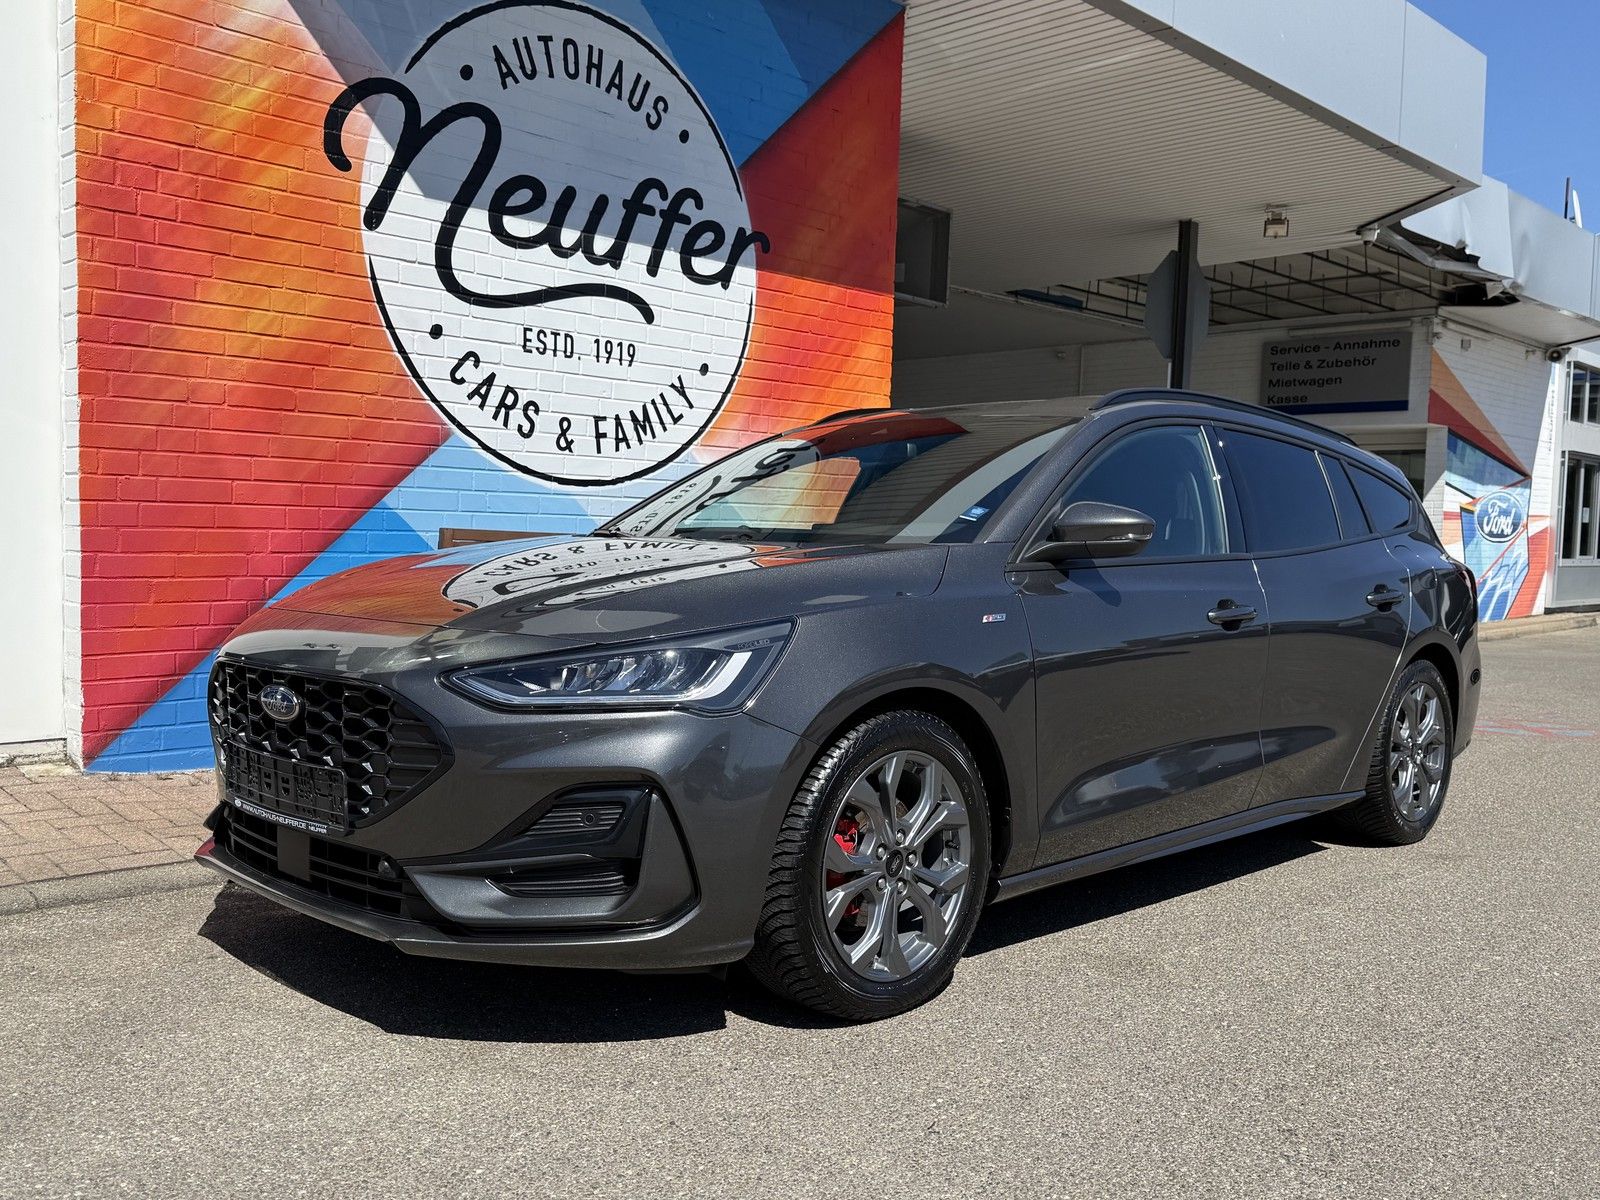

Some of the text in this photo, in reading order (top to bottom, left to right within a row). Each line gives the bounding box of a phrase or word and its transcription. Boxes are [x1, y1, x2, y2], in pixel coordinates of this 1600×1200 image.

[492, 34, 669, 131] AUTOHAUS
[323, 77, 770, 325] Neuffer
[522, 327, 637, 368] ESTD. 1919
[1270, 344, 1321, 356] Service
[1333, 339, 1401, 351] Annahme
[1271, 356, 1377, 372] Teile & Zubehör
[1268, 375, 1343, 389] Mietwagen
[450, 350, 697, 455] CARS & FAMILY
[1267, 394, 1308, 405] Kasse
[1482, 500, 1517, 537] Ford
[266, 692, 288, 713] Ford
